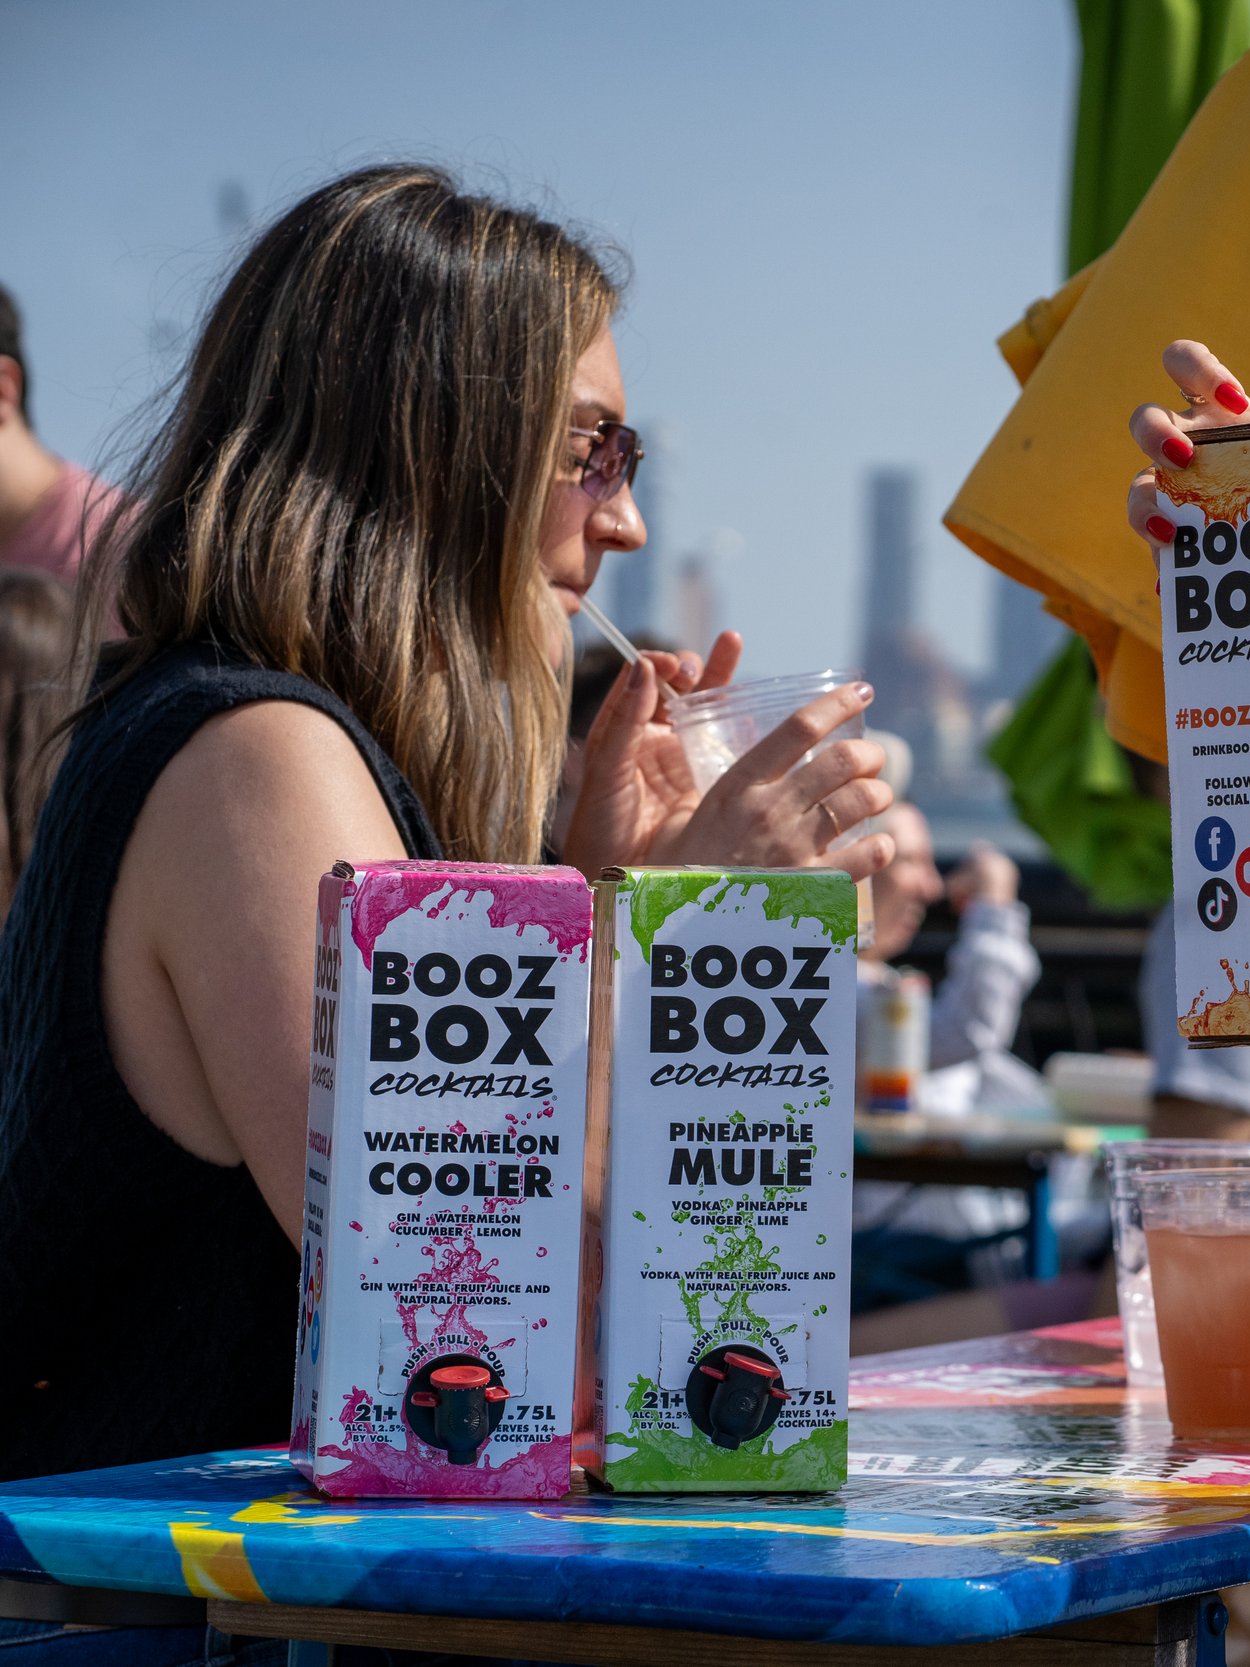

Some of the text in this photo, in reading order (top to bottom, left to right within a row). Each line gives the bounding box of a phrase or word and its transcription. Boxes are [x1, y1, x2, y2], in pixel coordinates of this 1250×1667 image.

[1207, 793, 1250, 807] SOCIAL
[651, 944, 832, 990] BOOZ
[372, 951, 558, 999] BOOZ
[313, 995, 336, 1059] BOX
[650, 996, 829, 1055] BOX
[370, 1003, 553, 1066] BOX
[650, 1061, 829, 1088] COCKTAILS
[370, 1072, 553, 1098] COCKTAILS
[670, 1122, 813, 1142] PINEAPPLE
[364, 1132, 559, 1155] WATERMELON
[668, 1148, 812, 1186] MULE
[369, 1162, 553, 1198] COOLER
[672, 1201, 807, 1211] VODKA PINEAPPLE
[397, 1213, 521, 1224] GIN WATERMELON
[690, 1215, 788, 1226] GINGER LIME
[396, 1227, 521, 1237] CUCUMBER LEMON
[640, 1271, 836, 1280] VODKA WITH REAL FRUIT JUICE AND
[361, 1282, 550, 1294] GIN WITH REAL FRUIT JUICE AND
[687, 1283, 791, 1292] NATURAL FLAVORS.
[400, 1295, 511, 1305] NATURAL FLAVORS.
[687, 1321, 789, 1365] PUSH PULL POUR
[401, 1345, 429, 1378] PUSH
[438, 1335, 470, 1346] PULL
[642, 1392, 684, 1409] 21+
[782, 1391, 836, 1406] .75L
[354, 1404, 397, 1422] 21+
[502, 1405, 555, 1420] .75L
[778, 1409, 836, 1418] ERVES 14+
[344, 1424, 406, 1432] ALC. 12.5%
[494, 1424, 529, 1432] ERVES
[778, 1419, 832, 1428] COCKTAILS
[494, 1434, 551, 1442] COCKTAILS
